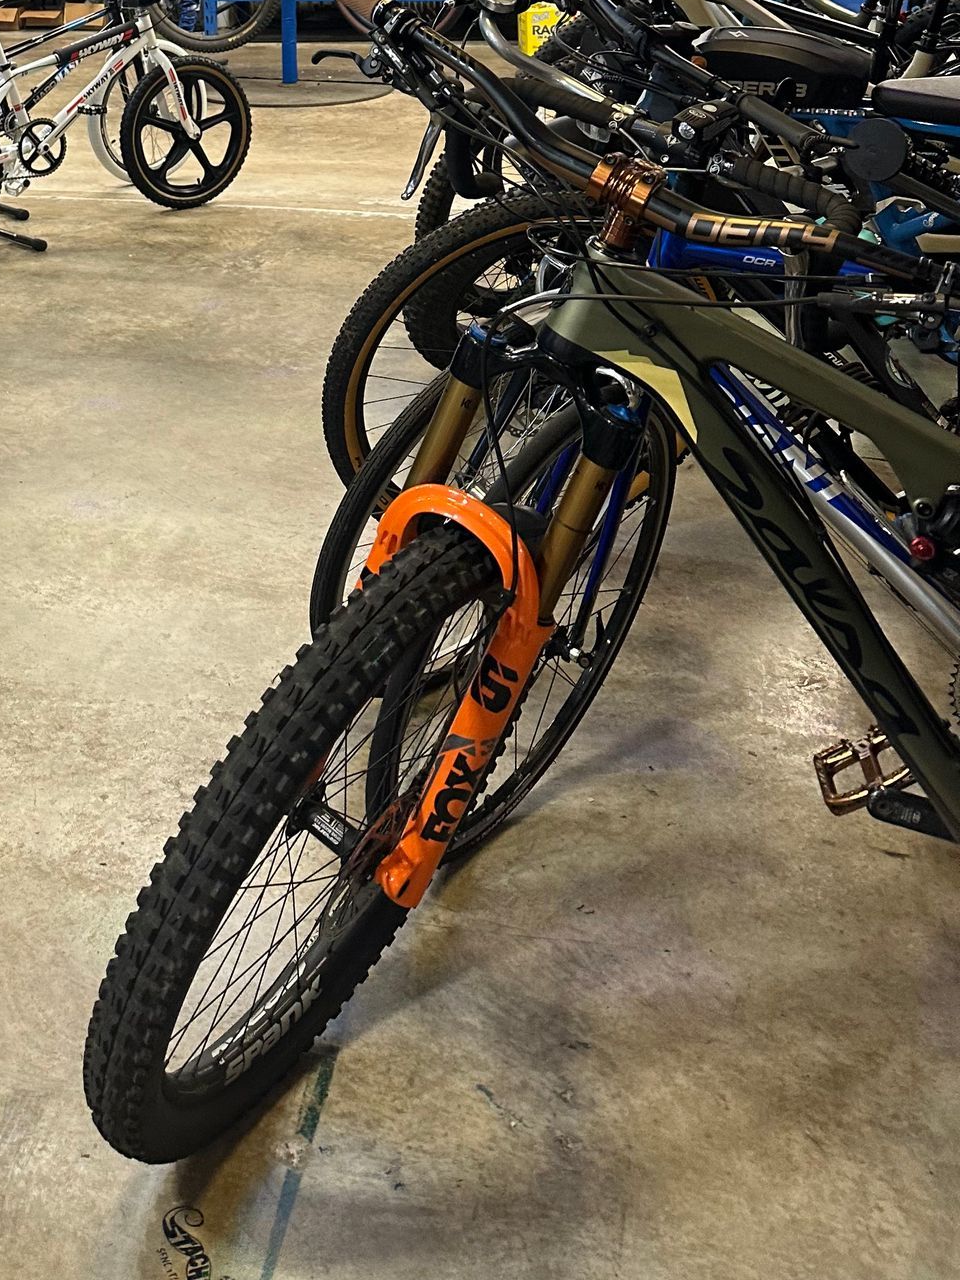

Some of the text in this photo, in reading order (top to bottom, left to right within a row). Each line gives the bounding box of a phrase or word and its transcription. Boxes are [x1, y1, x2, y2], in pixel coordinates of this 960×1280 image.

[78, 32, 124, 59] SKYWAY
[83, 74, 110, 100] SKYWAY
[685, 211, 841, 253] DEITY
[742, 255, 777, 268] OCR
[420, 751, 483, 843] FOX
